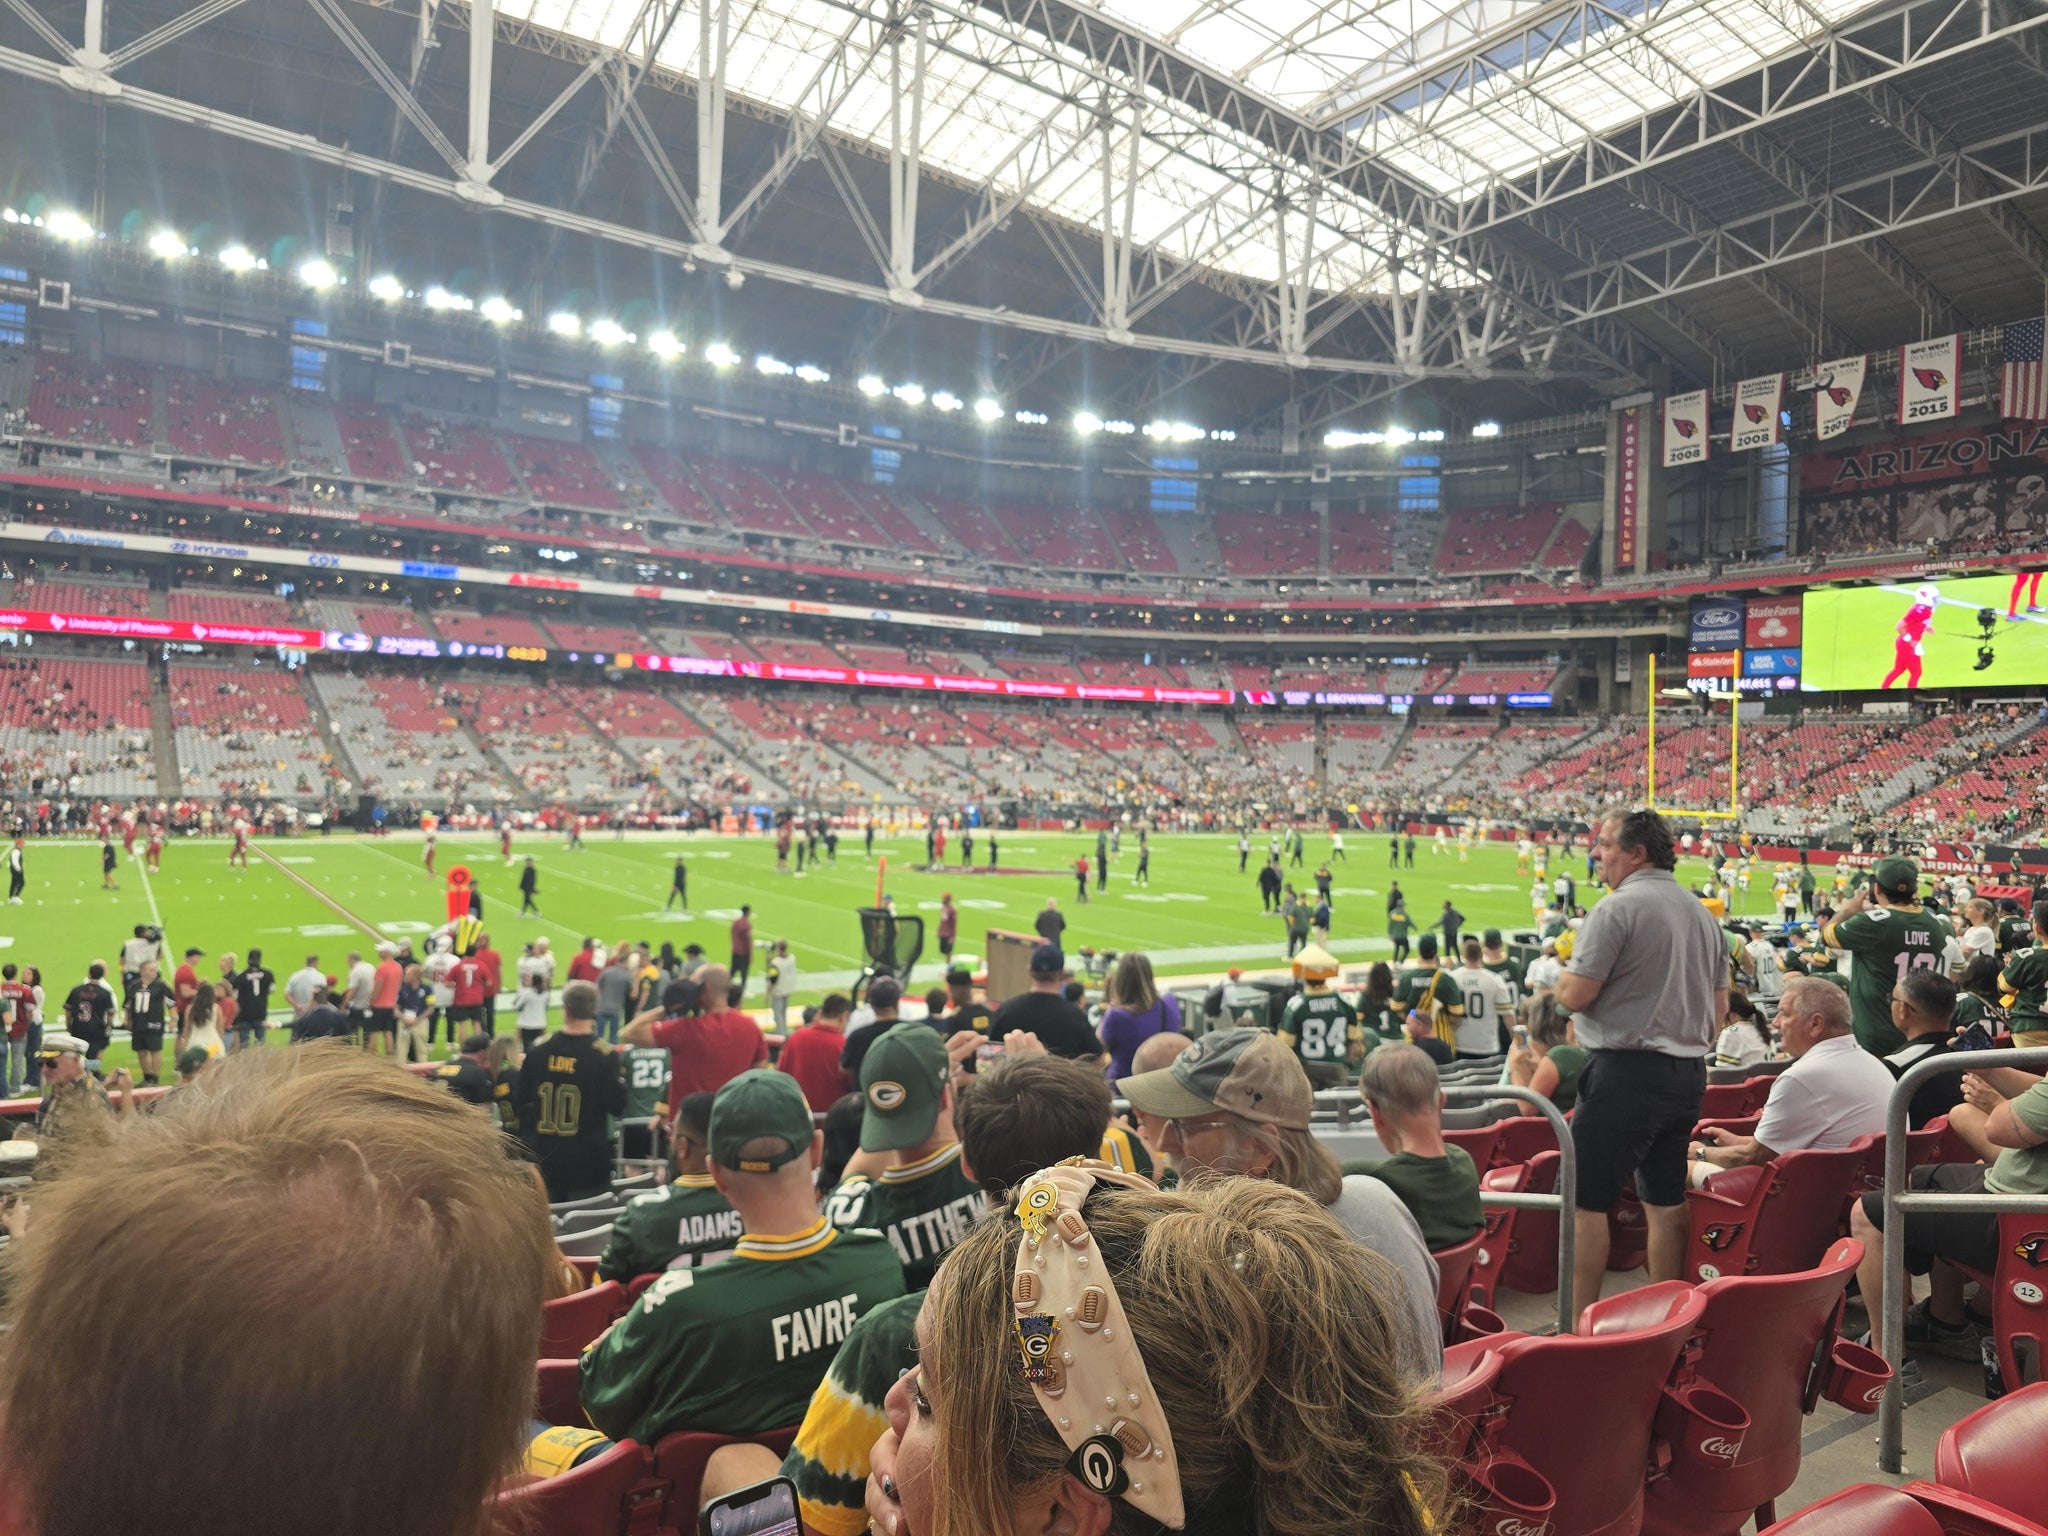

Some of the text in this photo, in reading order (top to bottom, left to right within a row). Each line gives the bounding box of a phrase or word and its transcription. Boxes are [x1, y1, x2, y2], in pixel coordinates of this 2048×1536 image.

[1928, 341, 1950, 351] WEST
[1908, 402, 1948, 417] 2015
[1737, 433, 1770, 446] 2008
[1670, 449, 1700, 462] 2008
[1833, 426, 2048, 484] ARIZONA
[308, 553, 340, 567] COX
[1912, 560, 1966, 572] CARDINALS
[1919, 860, 1993, 875] ARDINALS
[1904, 930, 1930, 946] LOVE
[1301, 1016, 1347, 1059] 84
[548, 1054, 577, 1074] LOVE
[632, 1059, 664, 1088] 23
[536, 1081, 582, 1136] 10
[678, 1210, 743, 1245] ADAMS
[887, 1189, 990, 1265] ATTHEW
[2020, 1287, 2036, 1298] 12
[771, 1293, 858, 1362] FAVRE
